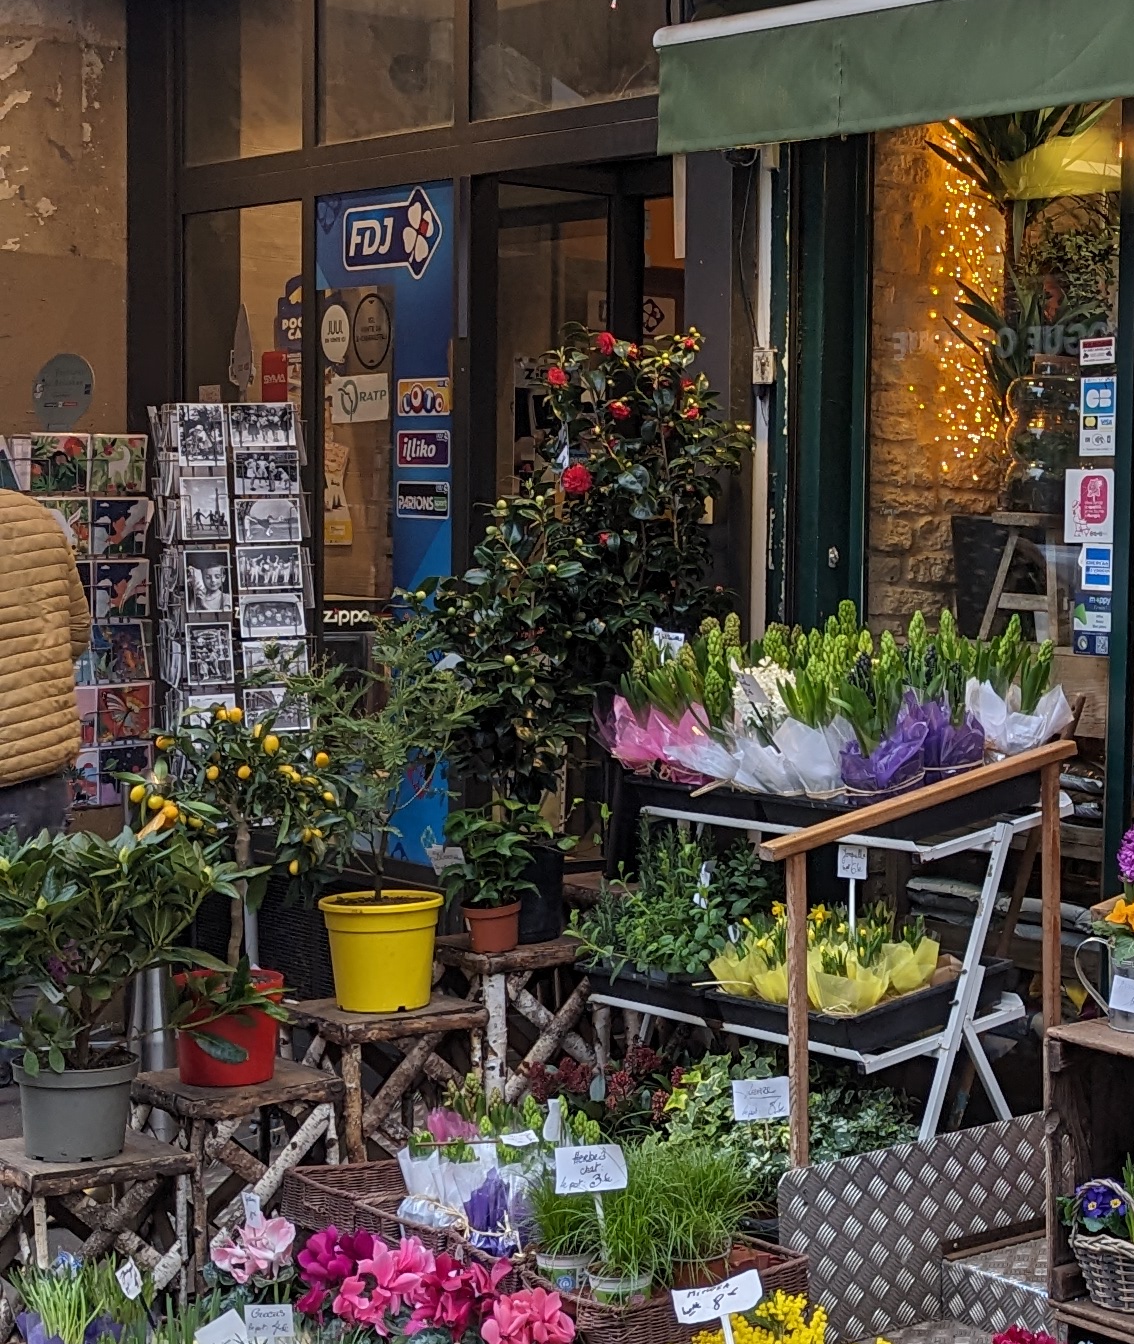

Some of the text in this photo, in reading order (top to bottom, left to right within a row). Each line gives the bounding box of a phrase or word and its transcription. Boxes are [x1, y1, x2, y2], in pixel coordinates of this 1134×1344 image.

[349, 217, 394, 257] FDJ
[359, 389, 387, 402] RATP
[403, 383, 445, 414] LOTO
[403, 437, 437, 461] illiko
[398, 495, 433, 511] PARIONS
[323, 608, 373, 626] zippo
